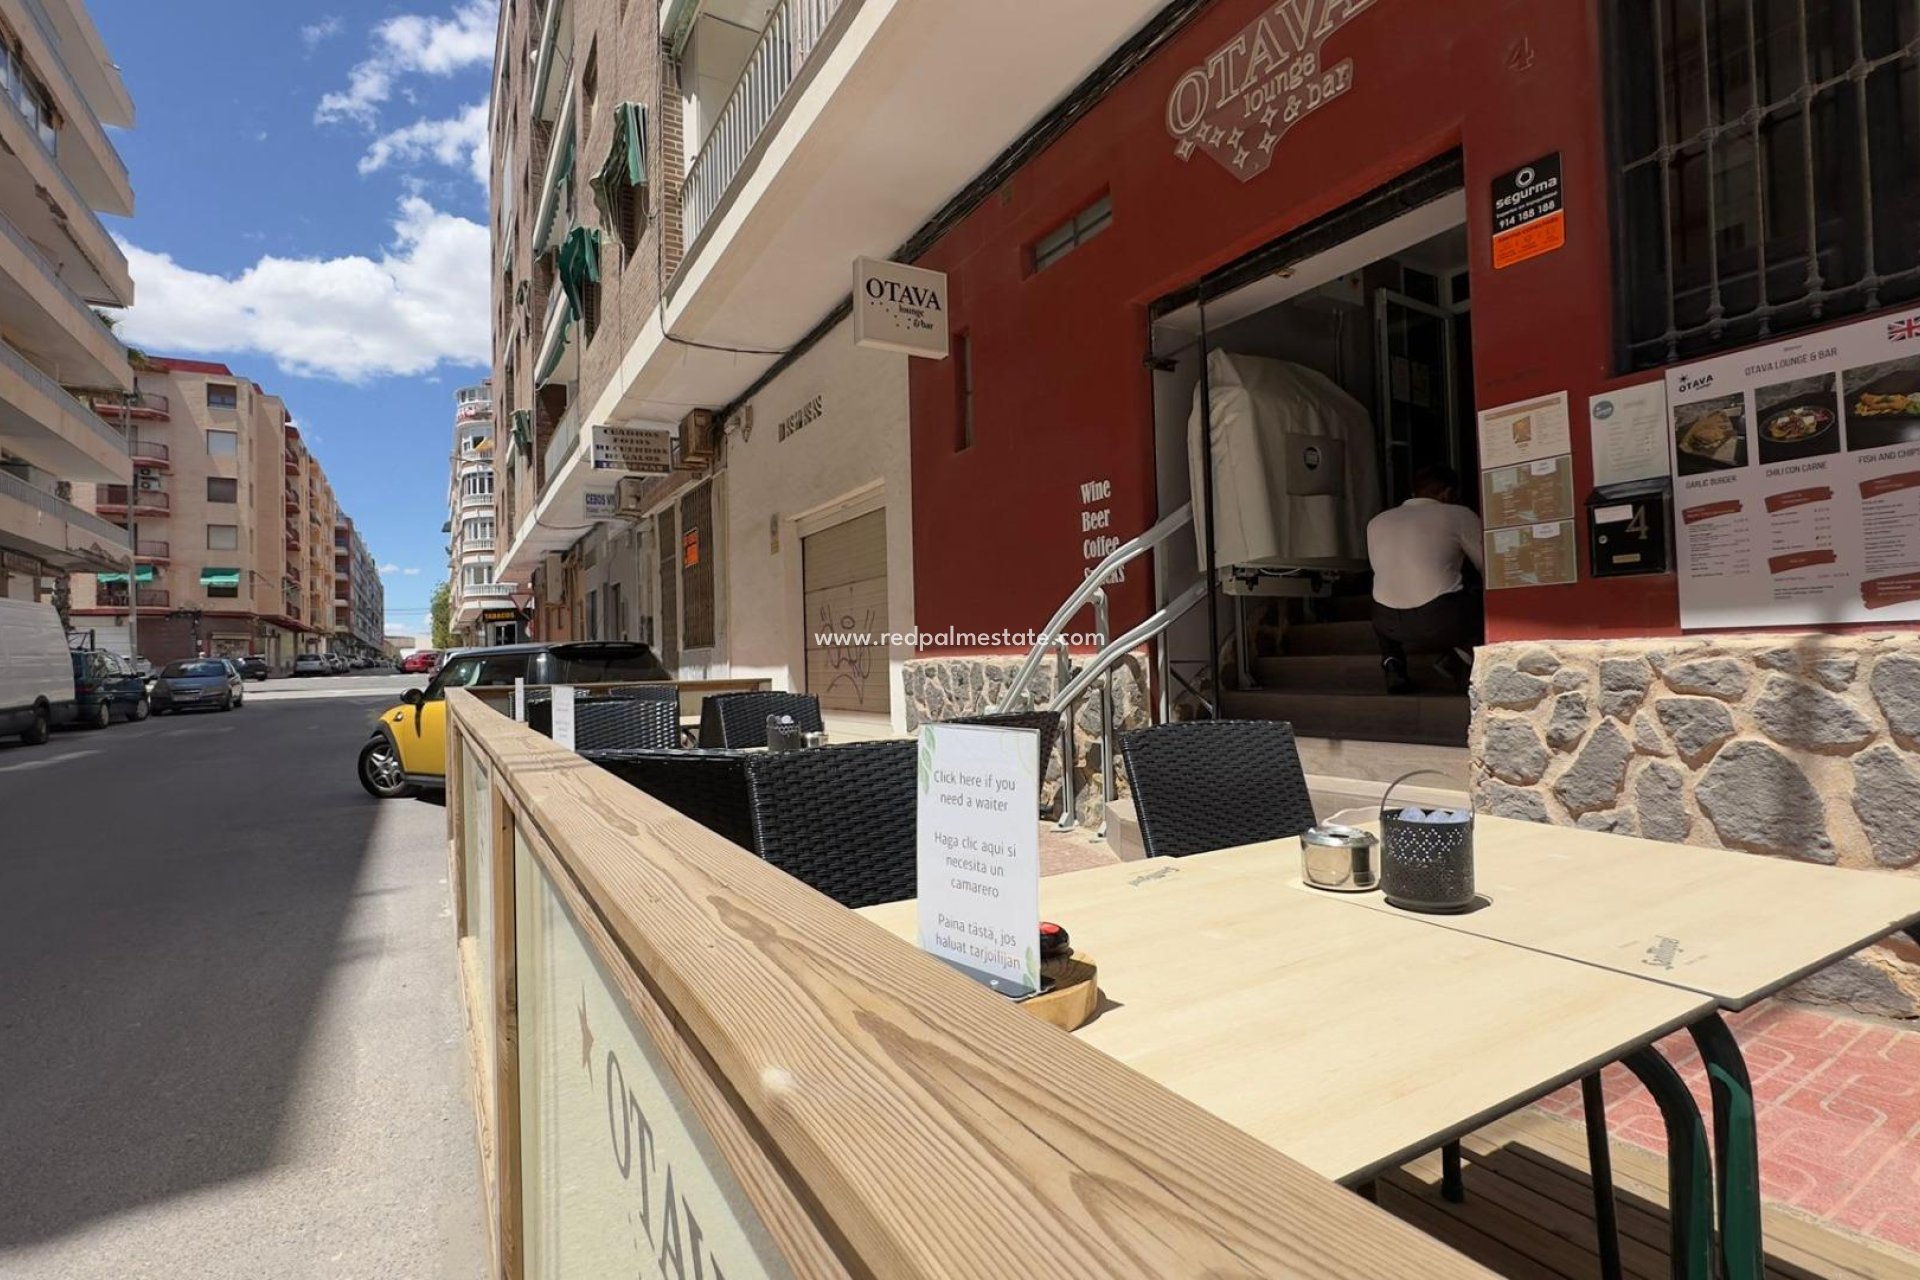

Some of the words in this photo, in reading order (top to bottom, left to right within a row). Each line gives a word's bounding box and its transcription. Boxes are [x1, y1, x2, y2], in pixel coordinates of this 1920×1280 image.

[1243, 53, 1315, 118] lounge
[1283, 95, 1302, 122] &
[1305, 64, 1350, 110] bar
[1495, 177, 1558, 209] segurma
[866, 277, 941, 311] OTAVA
[1745, 362, 1773, 376] OTAVA
[1775, 352, 1808, 371] LOUNGE
[1818, 347, 1838, 360] BAR
[1678, 374, 1714, 393] OTAVA
[1080, 479, 1111, 505] Wine
[1082, 508, 1110, 532] Beer
[1625, 504, 1650, 540] 4
[1083, 535, 1120, 560] Coffee
[934, 770, 956, 784] Click
[960, 772, 982, 787] here
[985, 774, 993, 788] if
[996, 778, 1016, 792] you
[940, 793, 964, 806] need
[966, 797, 972, 807] a
[976, 797, 1008, 812] waiter
[934, 832, 958, 850] Haga
[962, 836, 978, 851] clic
[946, 856, 987, 874] necesita
[990, 866, 1004, 877] un
[950, 878, 1000, 898] camarero
[938, 913, 965, 932] Paina
[1000, 930, 1016, 947] jos
[936, 932, 967, 954] haluat
